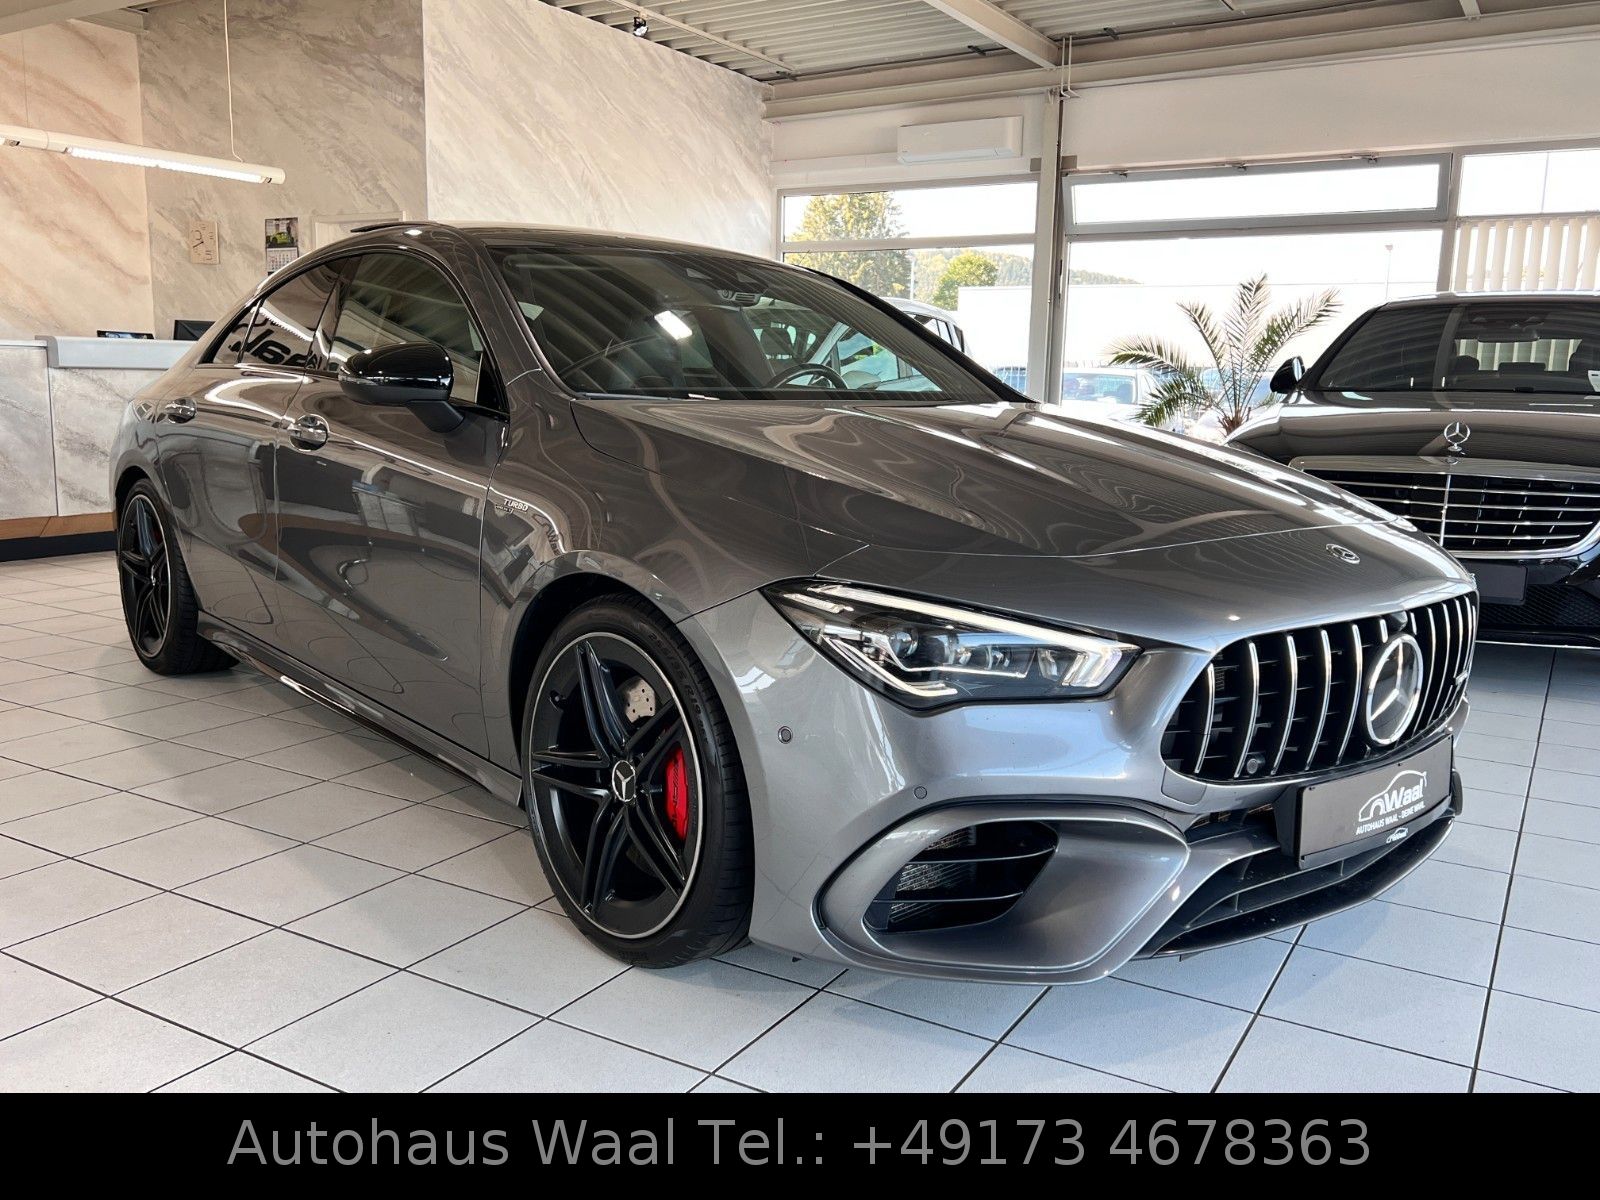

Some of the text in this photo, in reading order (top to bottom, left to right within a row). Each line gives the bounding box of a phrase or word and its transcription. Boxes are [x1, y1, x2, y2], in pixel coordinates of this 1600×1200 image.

[503, 498, 529, 511] TURBO
[1384, 778, 1424, 812] Waal
[1355, 818, 1385, 835] AUTOHAUS
